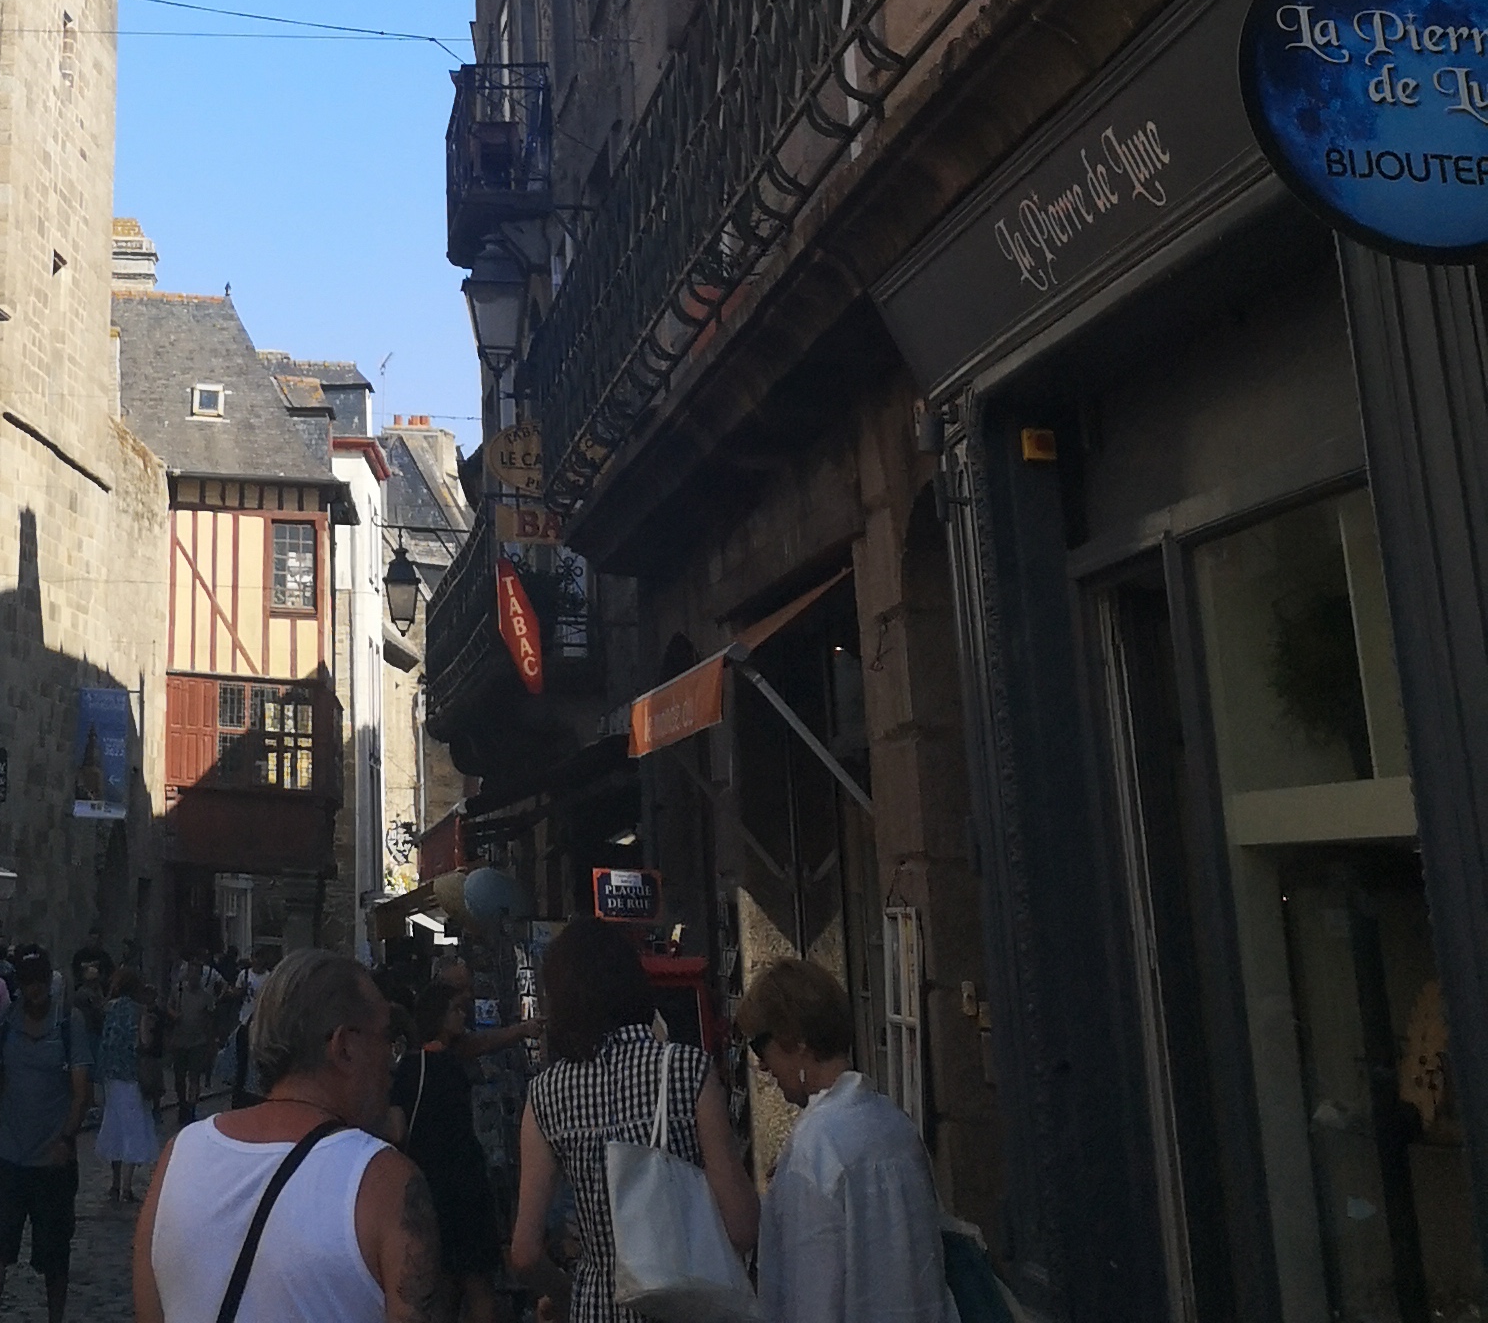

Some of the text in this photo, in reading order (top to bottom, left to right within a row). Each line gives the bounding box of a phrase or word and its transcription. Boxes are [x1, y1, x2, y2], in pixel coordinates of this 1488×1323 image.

[1276, 2, 1350, 64] La
[1368, 63, 1420, 105] de
[995, 121, 1170, 291] La Pierre de Lune
[500, 451, 516, 466] LE
[502, 576, 538, 676] TABAC
[605, 884, 652, 898] PLAQUE
[607, 898, 624, 909] DE
